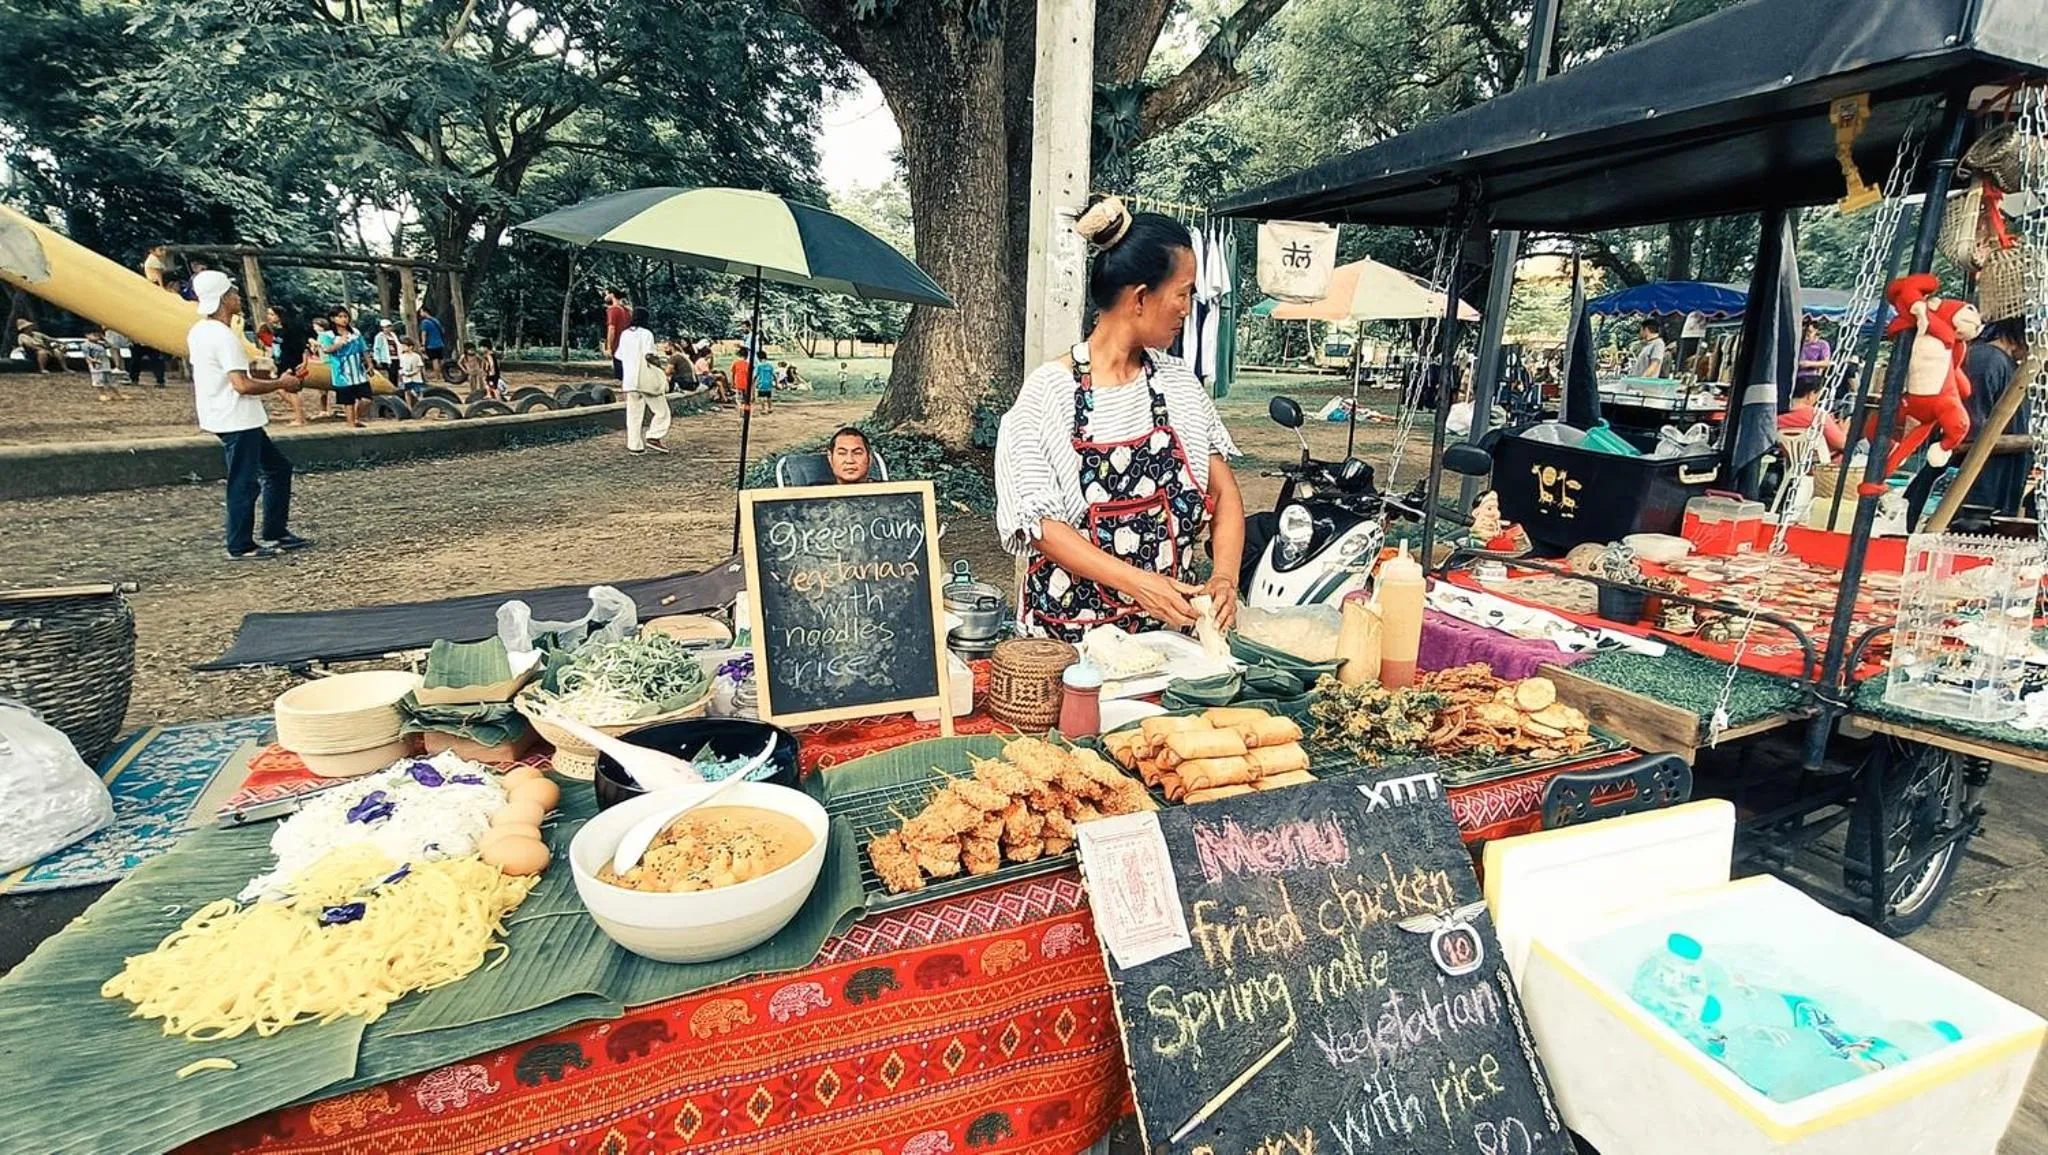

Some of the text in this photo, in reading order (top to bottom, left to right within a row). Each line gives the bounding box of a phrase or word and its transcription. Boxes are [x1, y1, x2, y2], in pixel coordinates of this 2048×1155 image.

[818, 583, 884, 621] with
[783, 617, 895, 648] noodles
[794, 653, 869, 688] rice
[1192, 808, 1351, 884] Menu
[1430, 1053, 1505, 1150] rice
